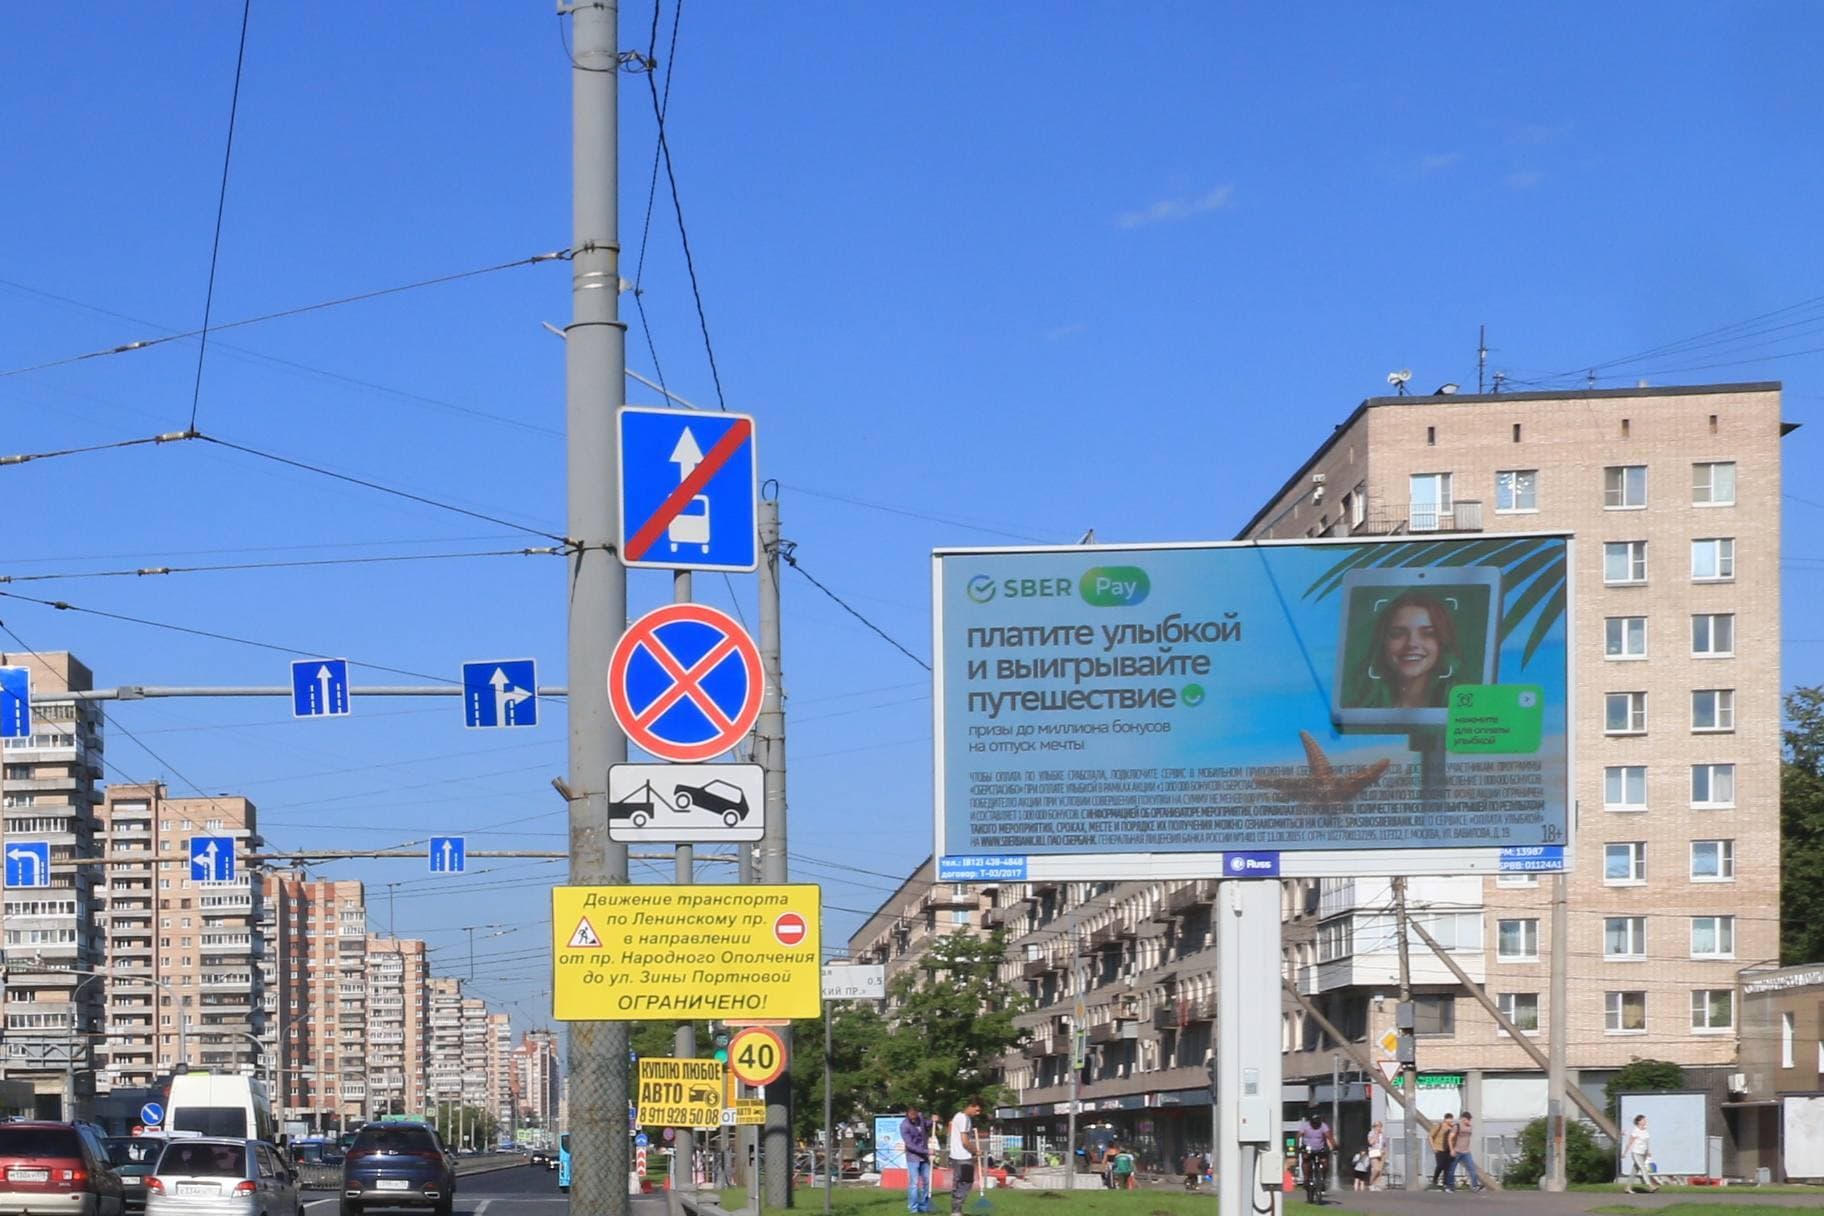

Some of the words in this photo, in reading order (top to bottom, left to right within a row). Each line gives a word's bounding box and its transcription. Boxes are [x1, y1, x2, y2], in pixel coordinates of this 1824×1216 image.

[1003, 578, 1072, 597] SBER
[1095, 576, 1137, 600] Pay
[967, 624, 1094, 648] платите
[1101, 611, 1242, 652] улыбкой
[968, 660, 988, 680] и
[996, 645, 1211, 685] выигрывайте
[967, 686, 1177, 719] путешествие
[968, 724, 1014, 738] призы
[1016, 723, 1034, 736] до
[1038, 721, 1109, 735] миллиона
[1112, 719, 1172, 735] бонусов
[968, 741, 986, 752] на
[989, 740, 1036, 755] отпуск
[1039, 738, 1085, 752] мечты
[1541, 824, 1563, 843] 18+
[1246, 859, 1272, 869] Russ
[583, 893, 672, 909] Движение
[677, 894, 789, 907] транспорта
[606, 914, 628, 926] по
[632, 912, 737, 928] Ленинскому
[742, 913, 768, 928] пр.
[623, 934, 633, 944] в
[638, 933, 752, 948] направлении
[559, 954, 584, 965] от
[589, 953, 615, 968] пр.
[621, 951, 716, 966] Народного
[721, 951, 815, 965] Ополчения
[582, 972, 604, 985] до
[609, 972, 634, 987] ул.
[640, 970, 686, 984] Зины
[691, 970, 792, 984] Портновой
[617, 994, 768, 1011] ОГРАНИЧЕНО!
[738, 1043, 774, 1069] 40
[641, 1061, 680, 1079] КУПЛЮ
[683, 1062, 721, 1080] ЛЮБОЕ
[641, 1082, 683, 1103] АВТО
[639, 1107, 647, 1123] 8
[648, 1107, 665, 1123] 911
[667, 1107, 687, 1124] 928
[688, 1108, 703, 1124] 50
[705, 1109, 719, 1125] 08
